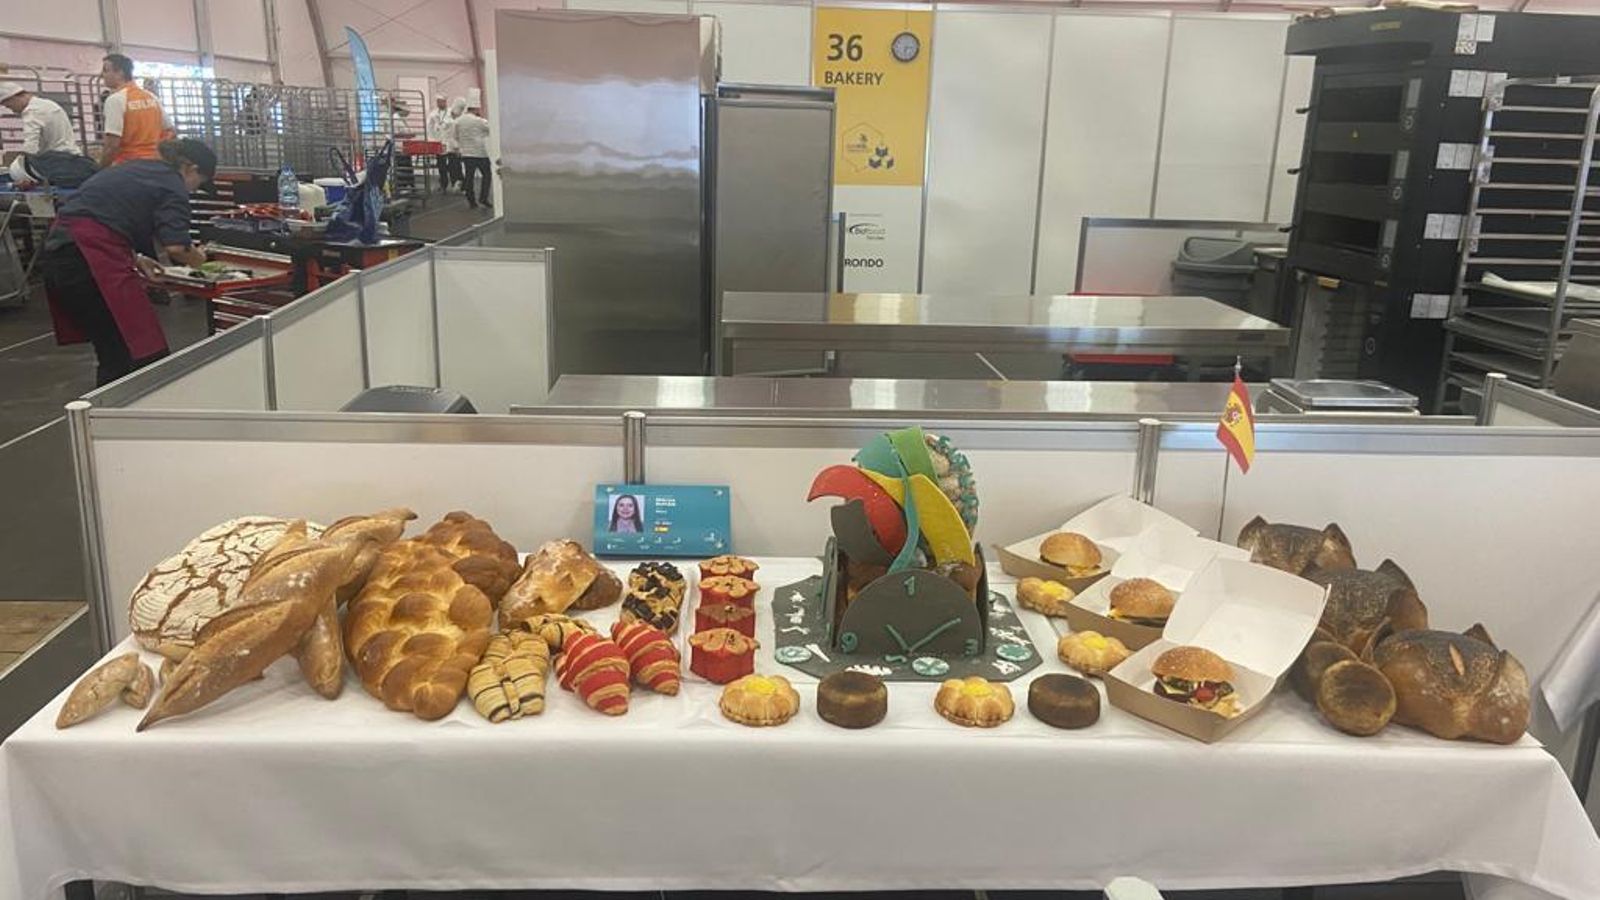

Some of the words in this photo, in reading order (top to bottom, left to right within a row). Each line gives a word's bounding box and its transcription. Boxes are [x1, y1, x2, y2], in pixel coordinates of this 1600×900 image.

[827, 34, 863, 63] 36
[825, 70, 885, 86] BAKERY
[844, 258, 884, 268] RONDO
